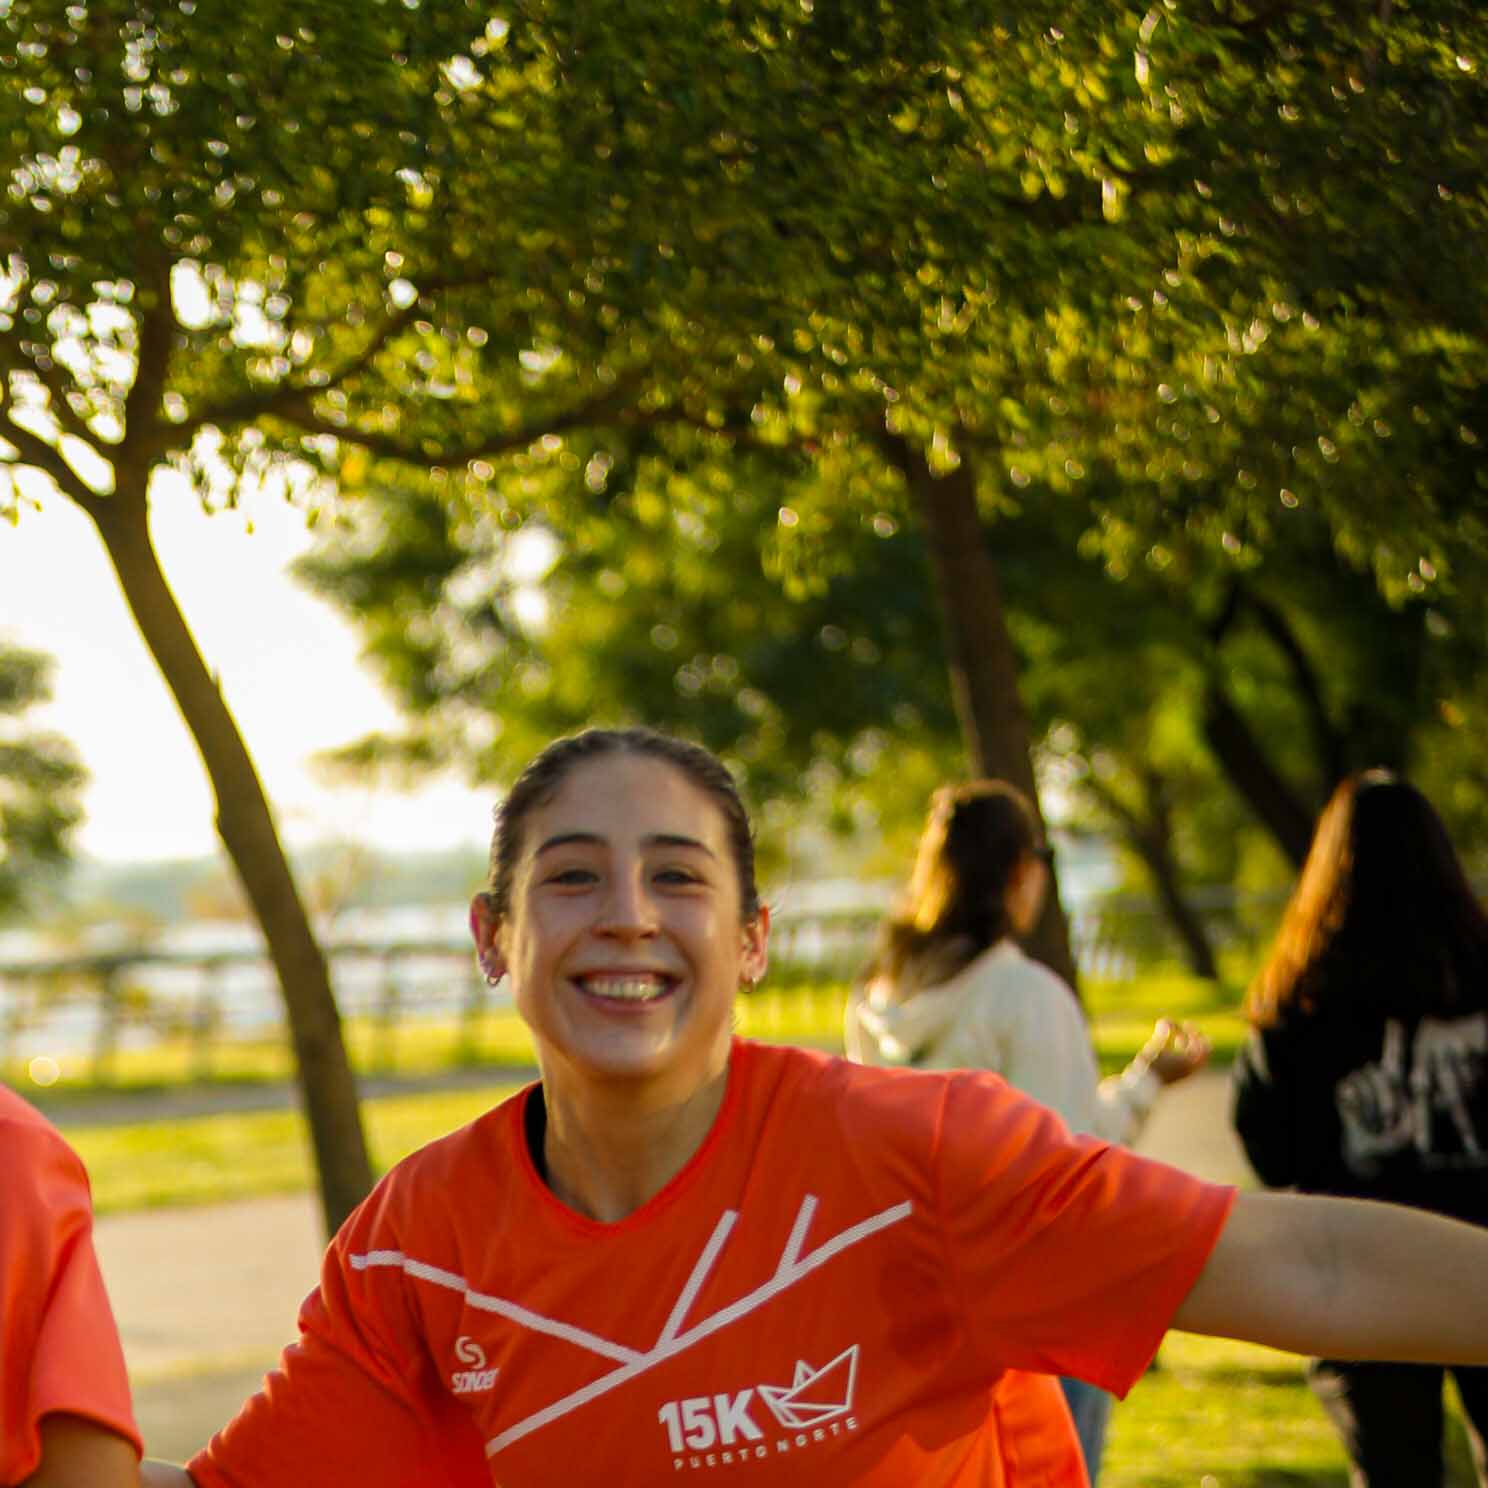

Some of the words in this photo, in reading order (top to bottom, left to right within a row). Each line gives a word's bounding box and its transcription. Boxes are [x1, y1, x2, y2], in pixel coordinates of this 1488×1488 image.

[658, 1388, 764, 1453] 15K
[673, 1445, 767, 1471] PUERTO
[776, 1416, 858, 1452] NORTE
